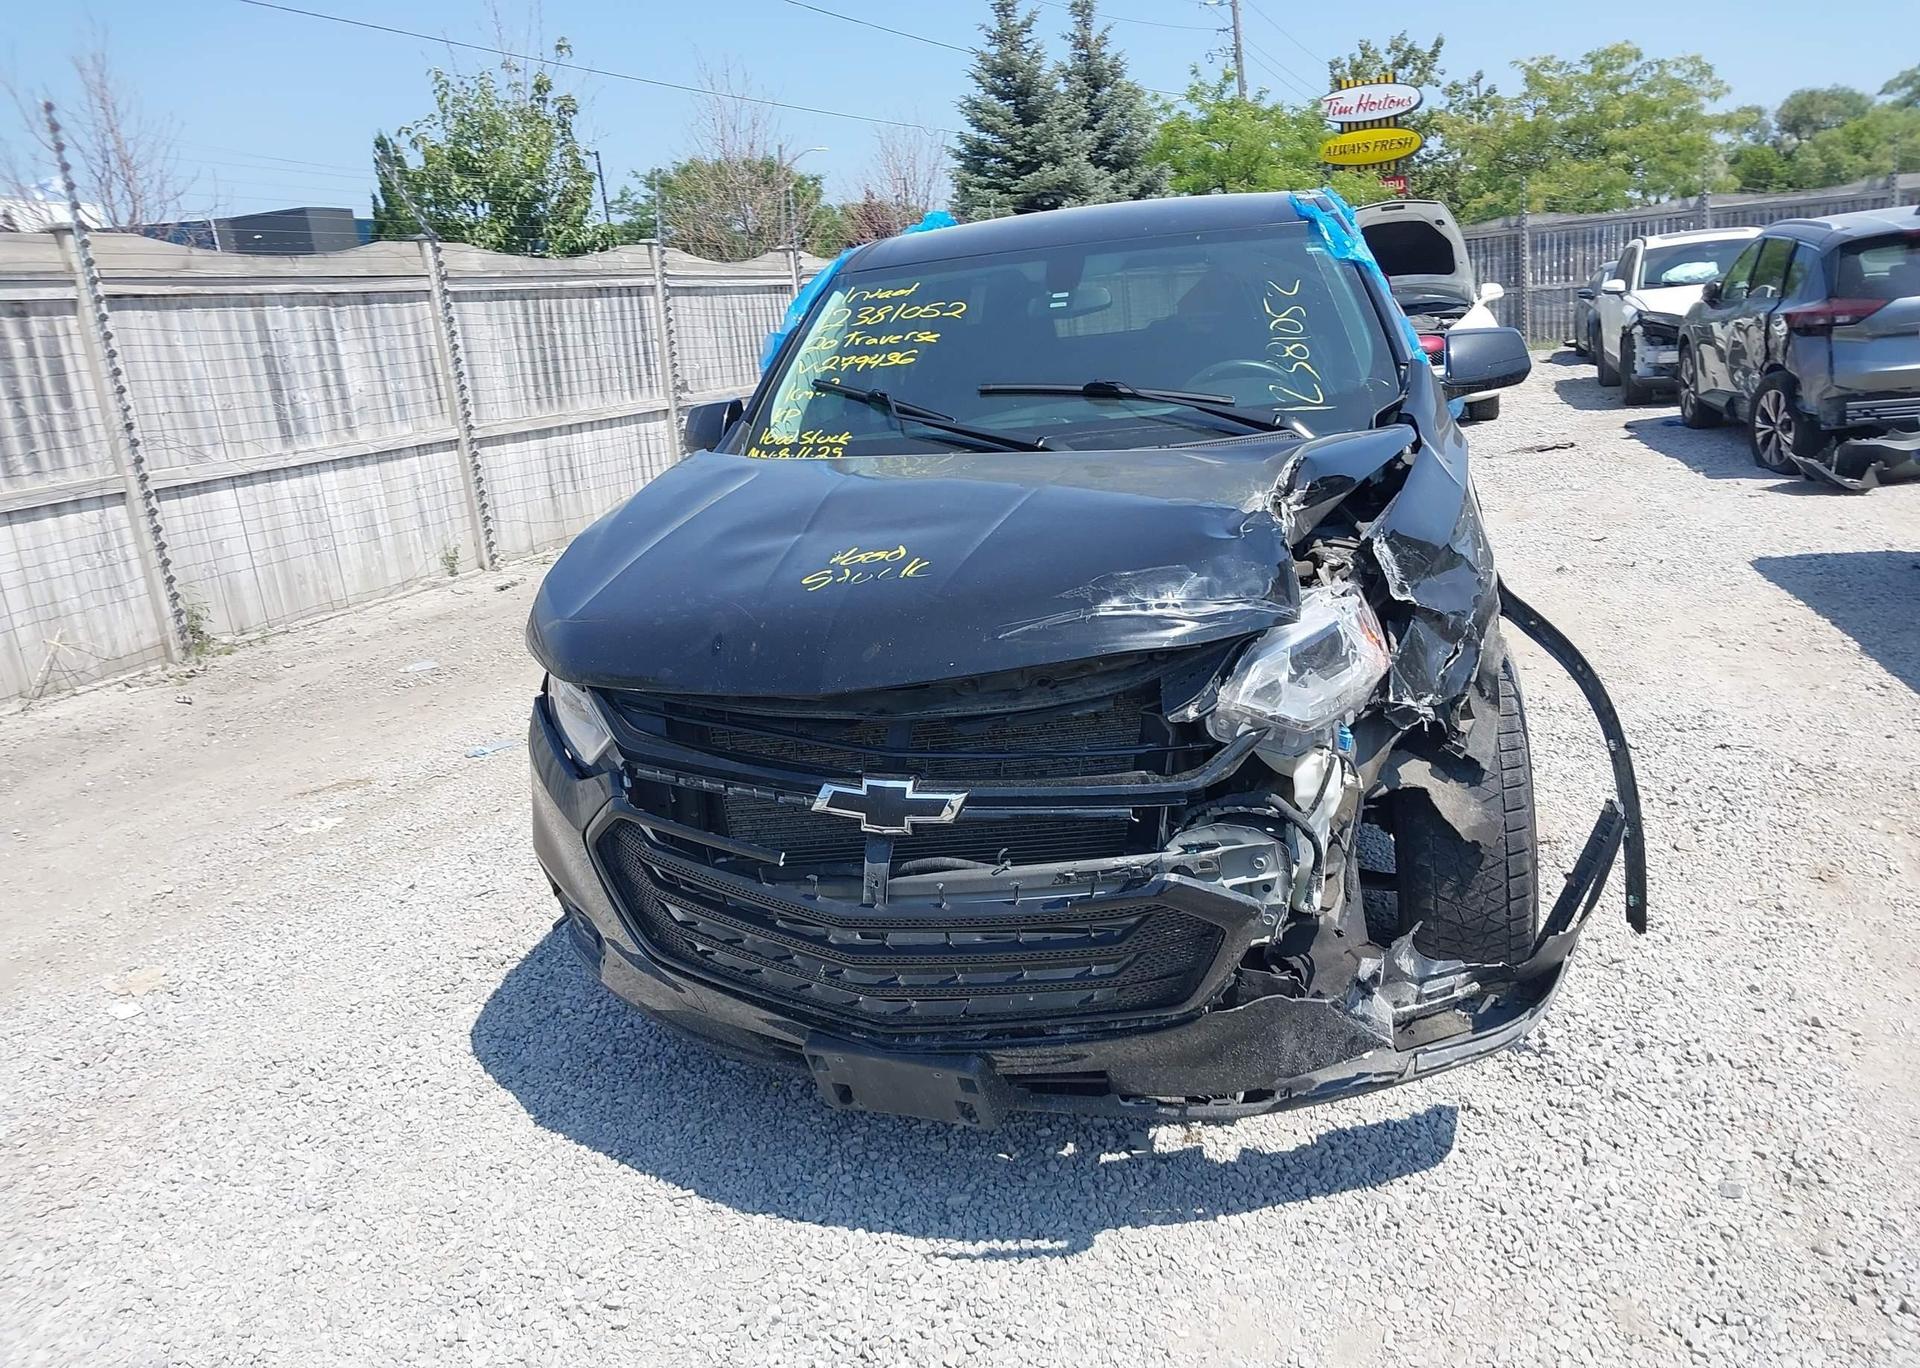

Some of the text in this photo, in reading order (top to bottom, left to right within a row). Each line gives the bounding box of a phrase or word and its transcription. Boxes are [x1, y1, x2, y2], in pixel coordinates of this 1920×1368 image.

[1322, 92, 1412, 117] Tim Hortons
[1325, 136, 1415, 156] ALWAYS FRESH
